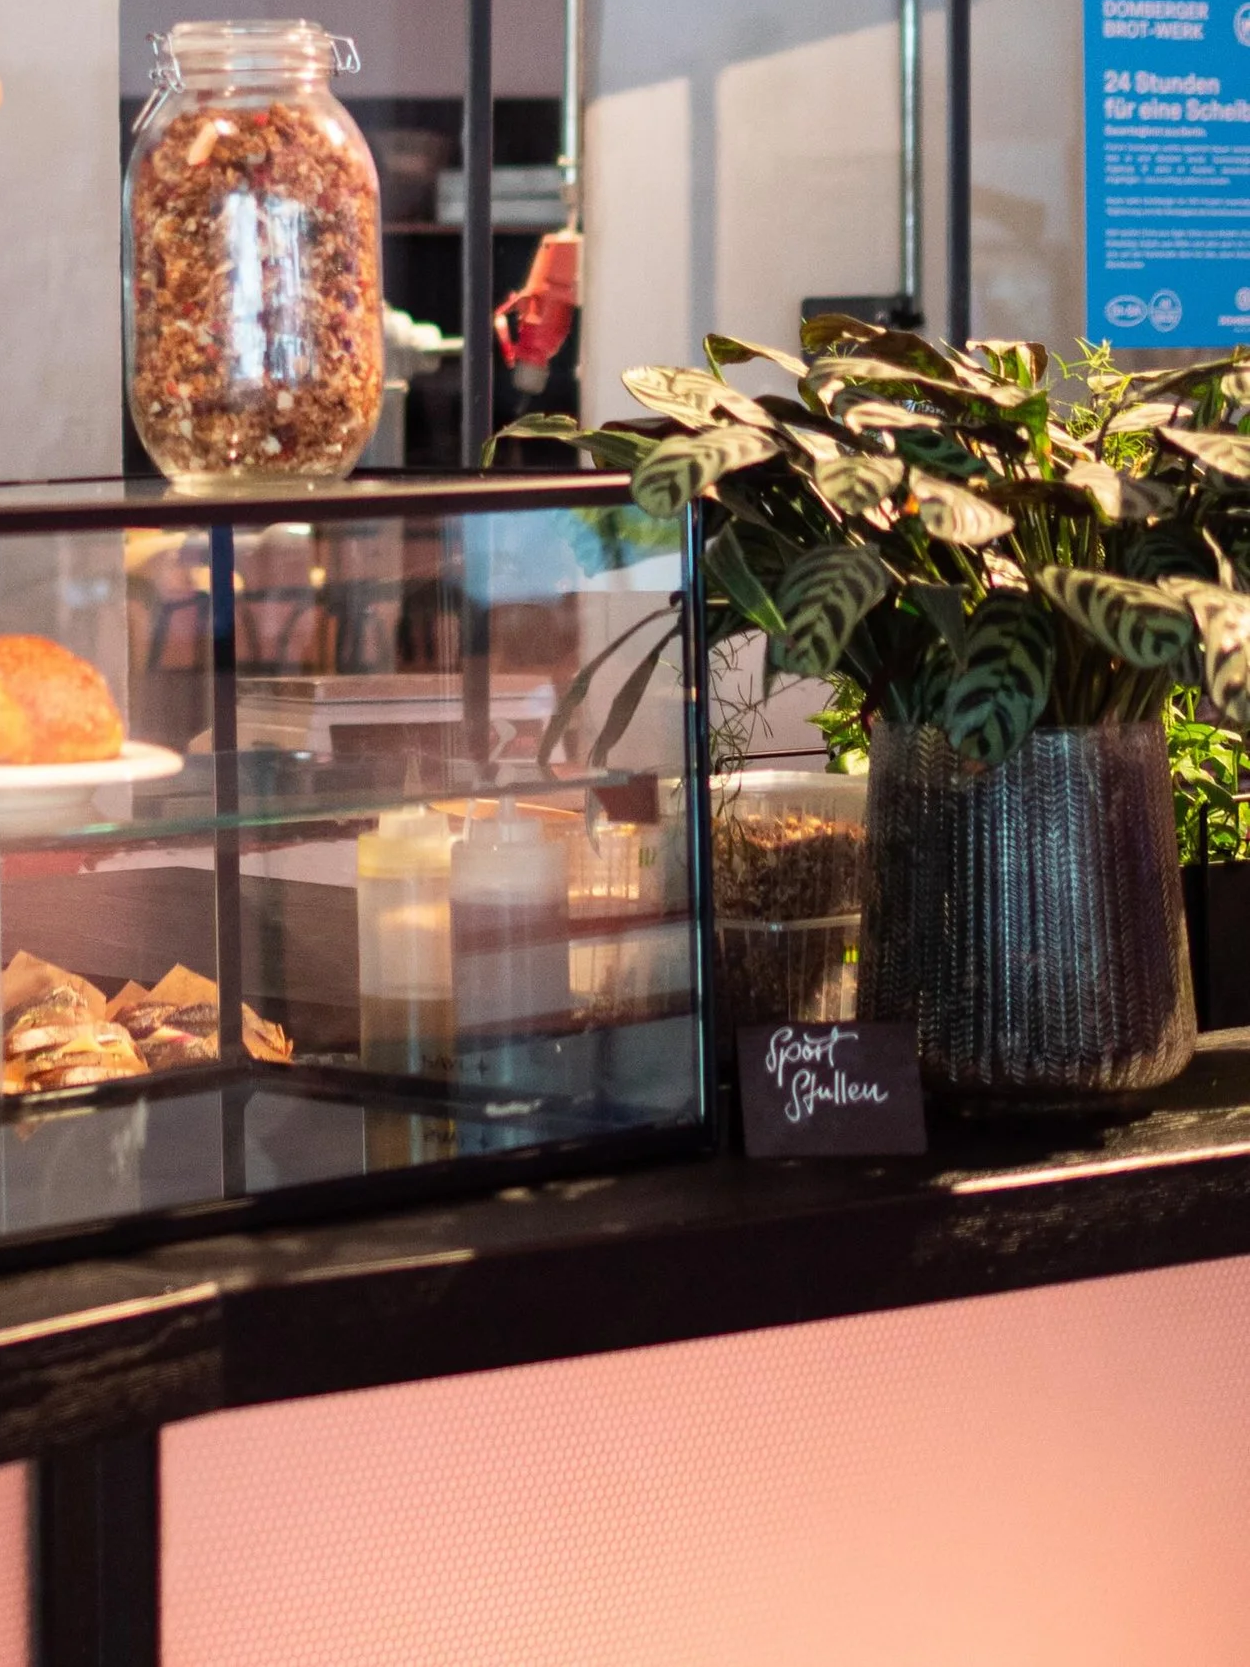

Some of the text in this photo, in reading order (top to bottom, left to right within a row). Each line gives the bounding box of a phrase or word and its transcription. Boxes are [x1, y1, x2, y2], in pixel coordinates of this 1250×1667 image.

[1103, 0, 1209, 20] DOMBERGER
[1103, 20, 1205, 40] BROT-WERK
[1104, 70, 1220, 95] 24 Stunden
[1104, 97, 1136, 120] für
[1138, 98, 1183, 121] eine
[765, 1025, 859, 1088] Sport
[784, 1068, 889, 1124] Stullen
